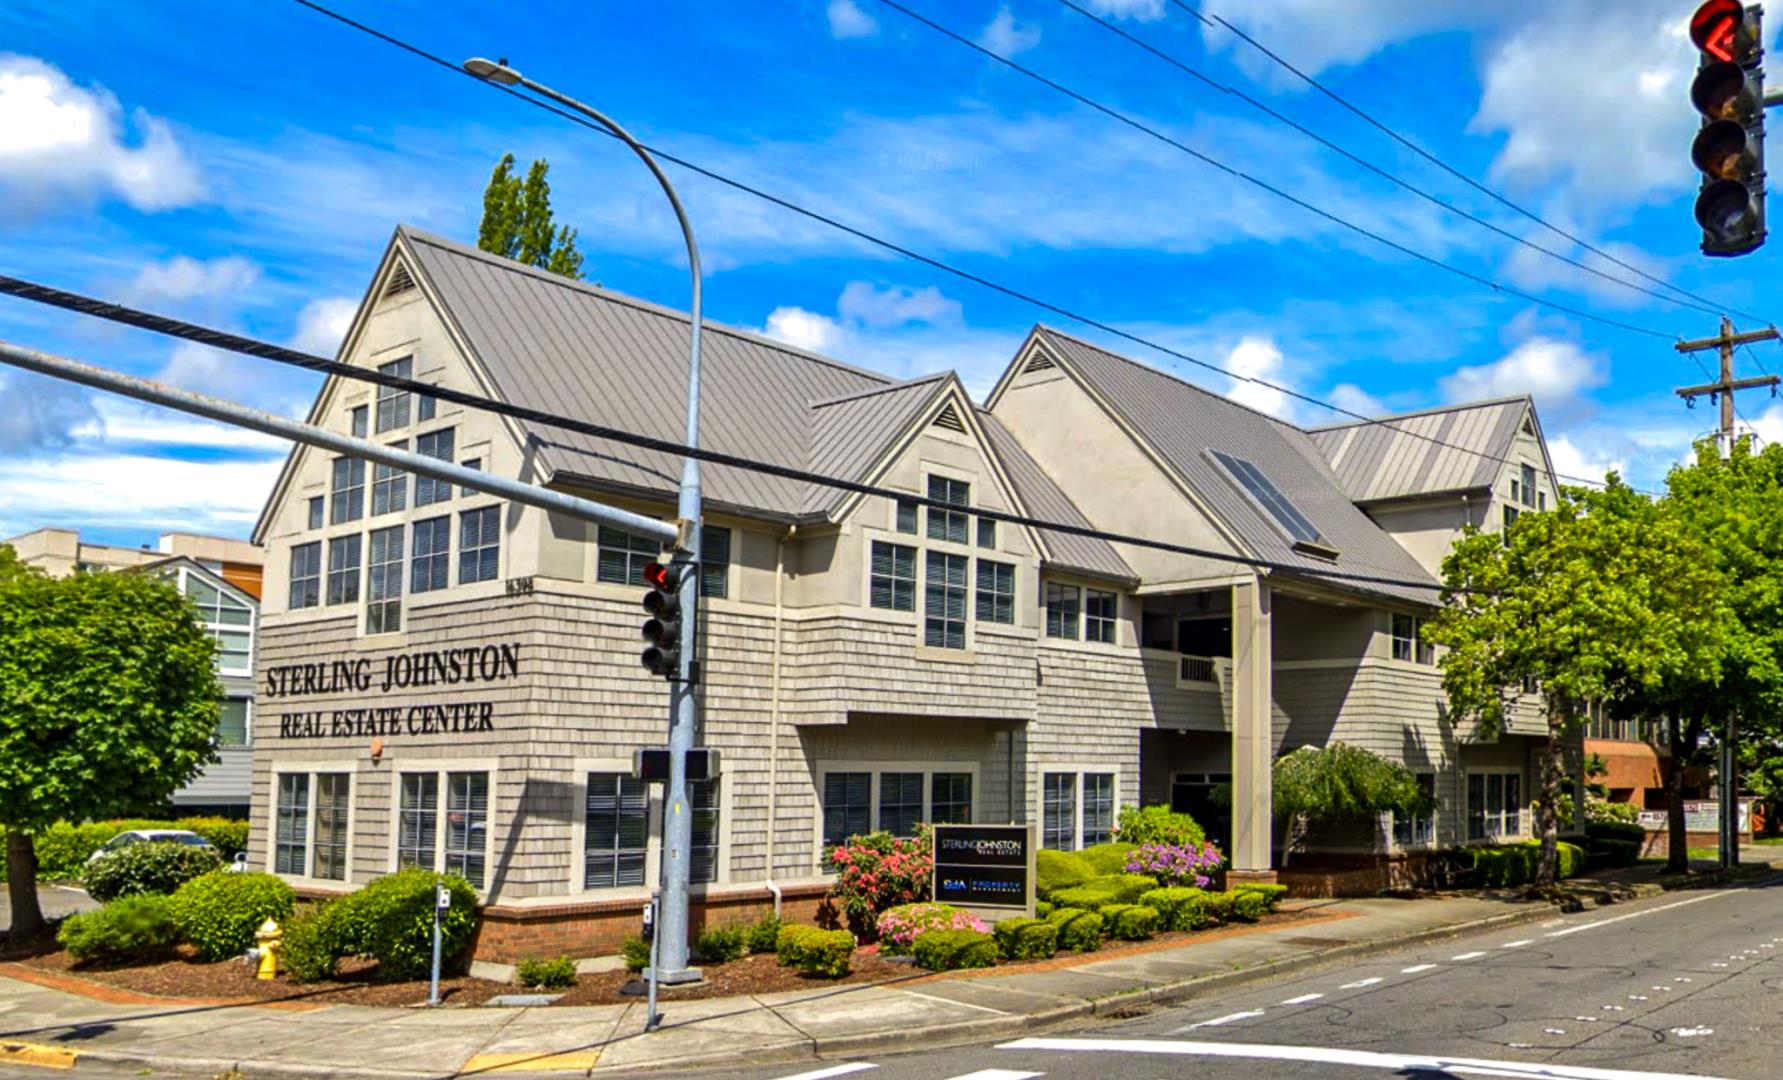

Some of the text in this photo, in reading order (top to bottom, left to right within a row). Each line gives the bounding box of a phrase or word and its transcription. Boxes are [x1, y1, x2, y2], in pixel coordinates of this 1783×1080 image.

[266, 643, 521, 698] STERLING JOHNSTON
[280, 702, 494, 739] REAL ESTATE CENTER
[973, 880, 1020, 888] PROPERTY
